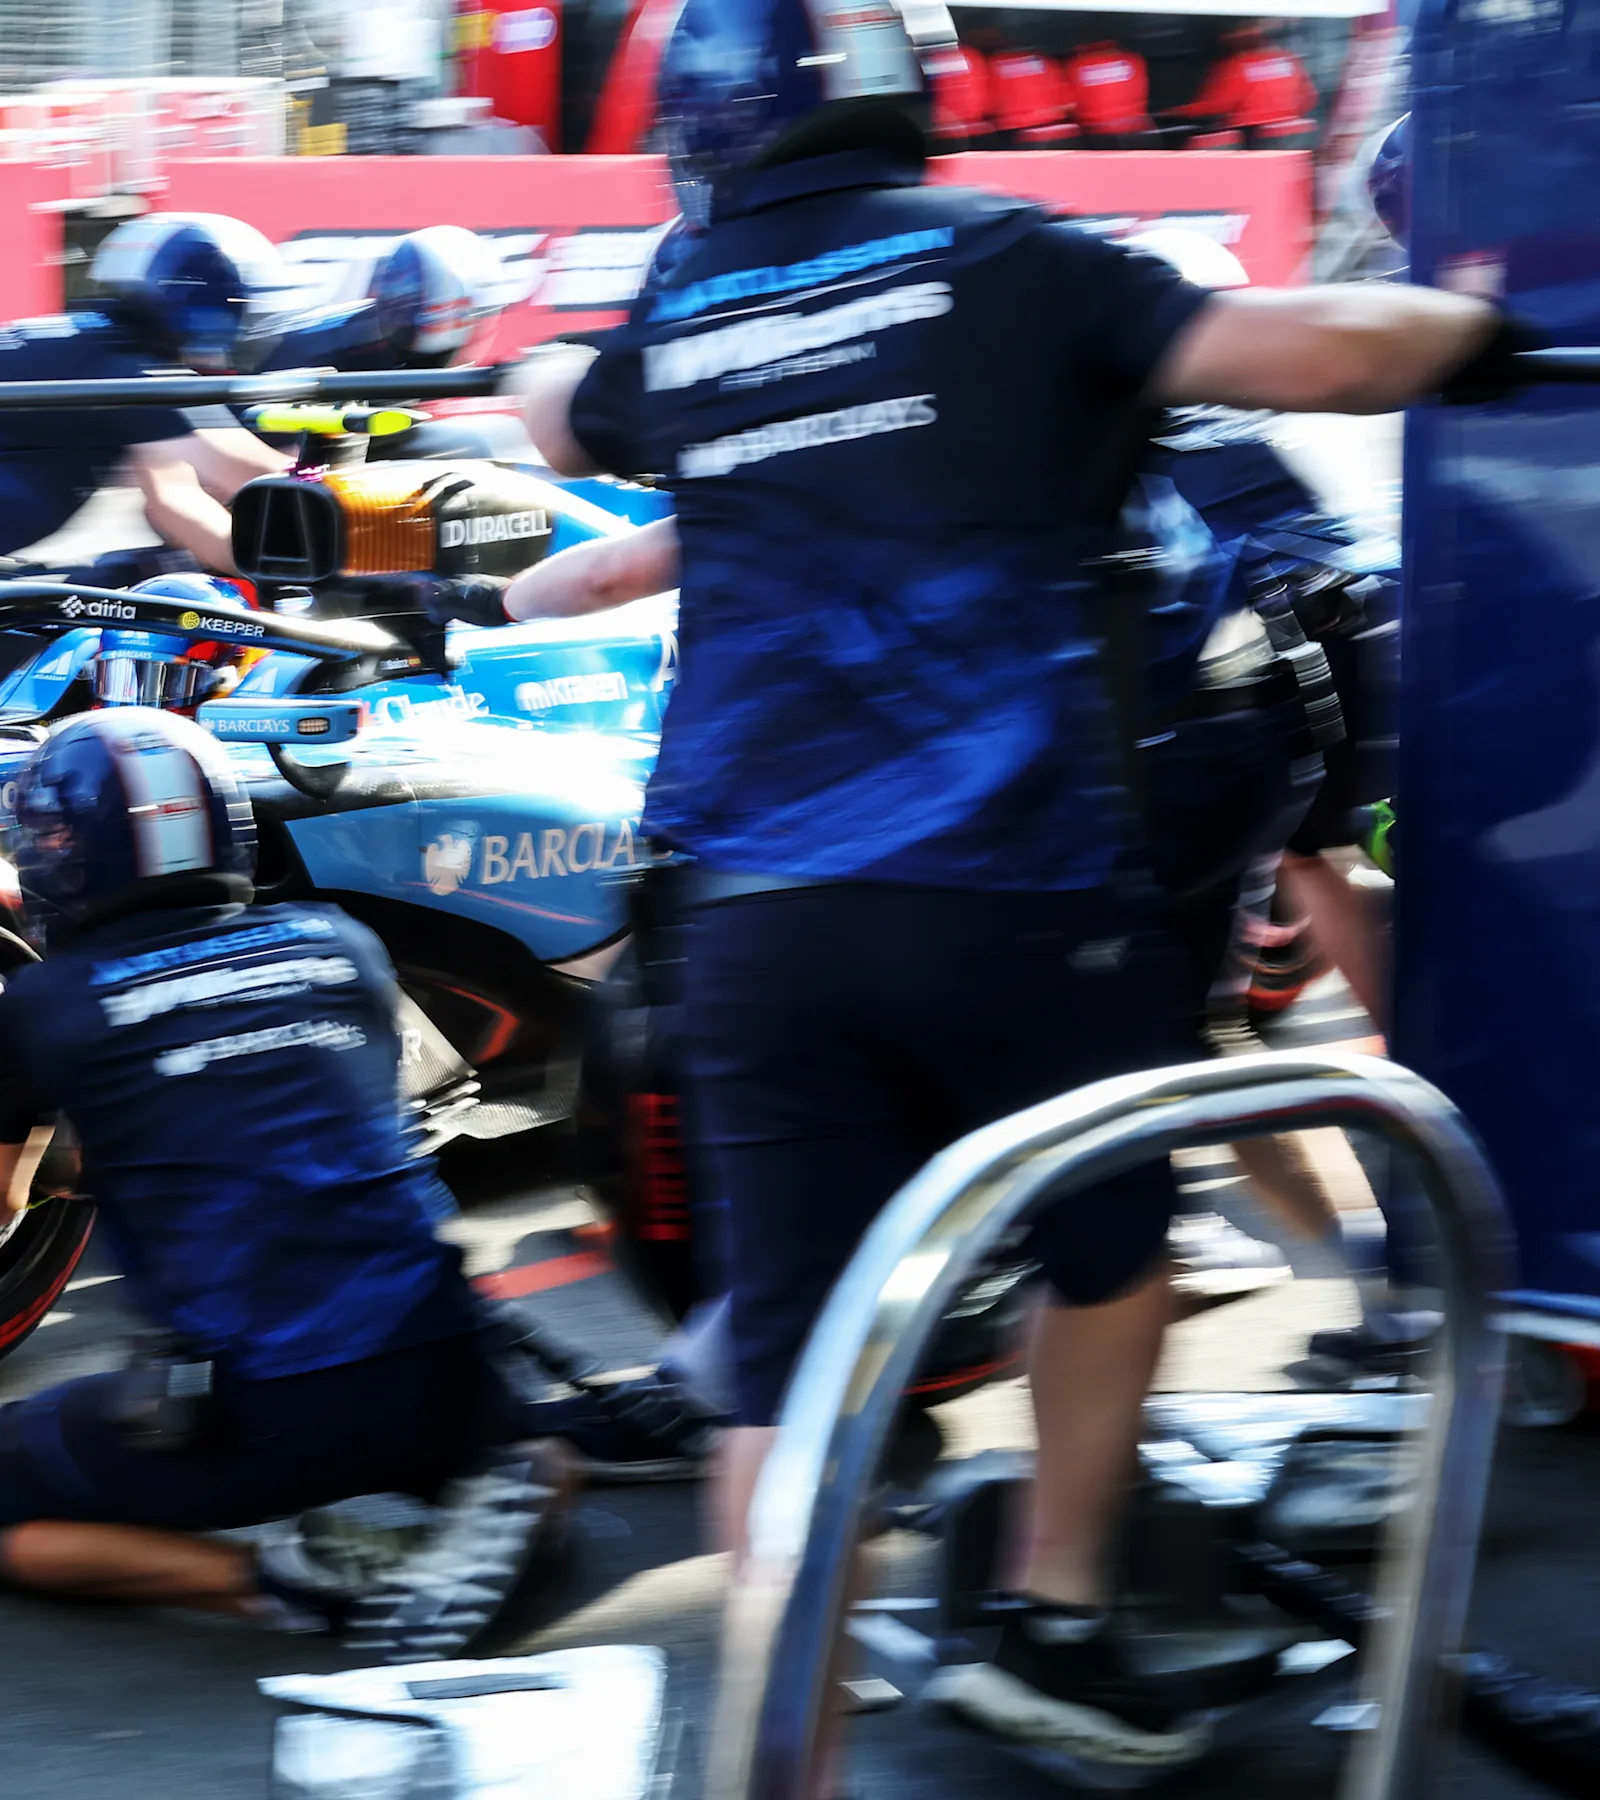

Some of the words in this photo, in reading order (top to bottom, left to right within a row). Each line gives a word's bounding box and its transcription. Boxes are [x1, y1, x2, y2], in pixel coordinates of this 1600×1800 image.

[440, 509, 552, 548] DURACELL
[87, 599, 136, 620] airia
[200, 617, 266, 638] KEEPER
[217, 718, 290, 733] BARCLAYS
[480, 816, 673, 885] BARCLA
